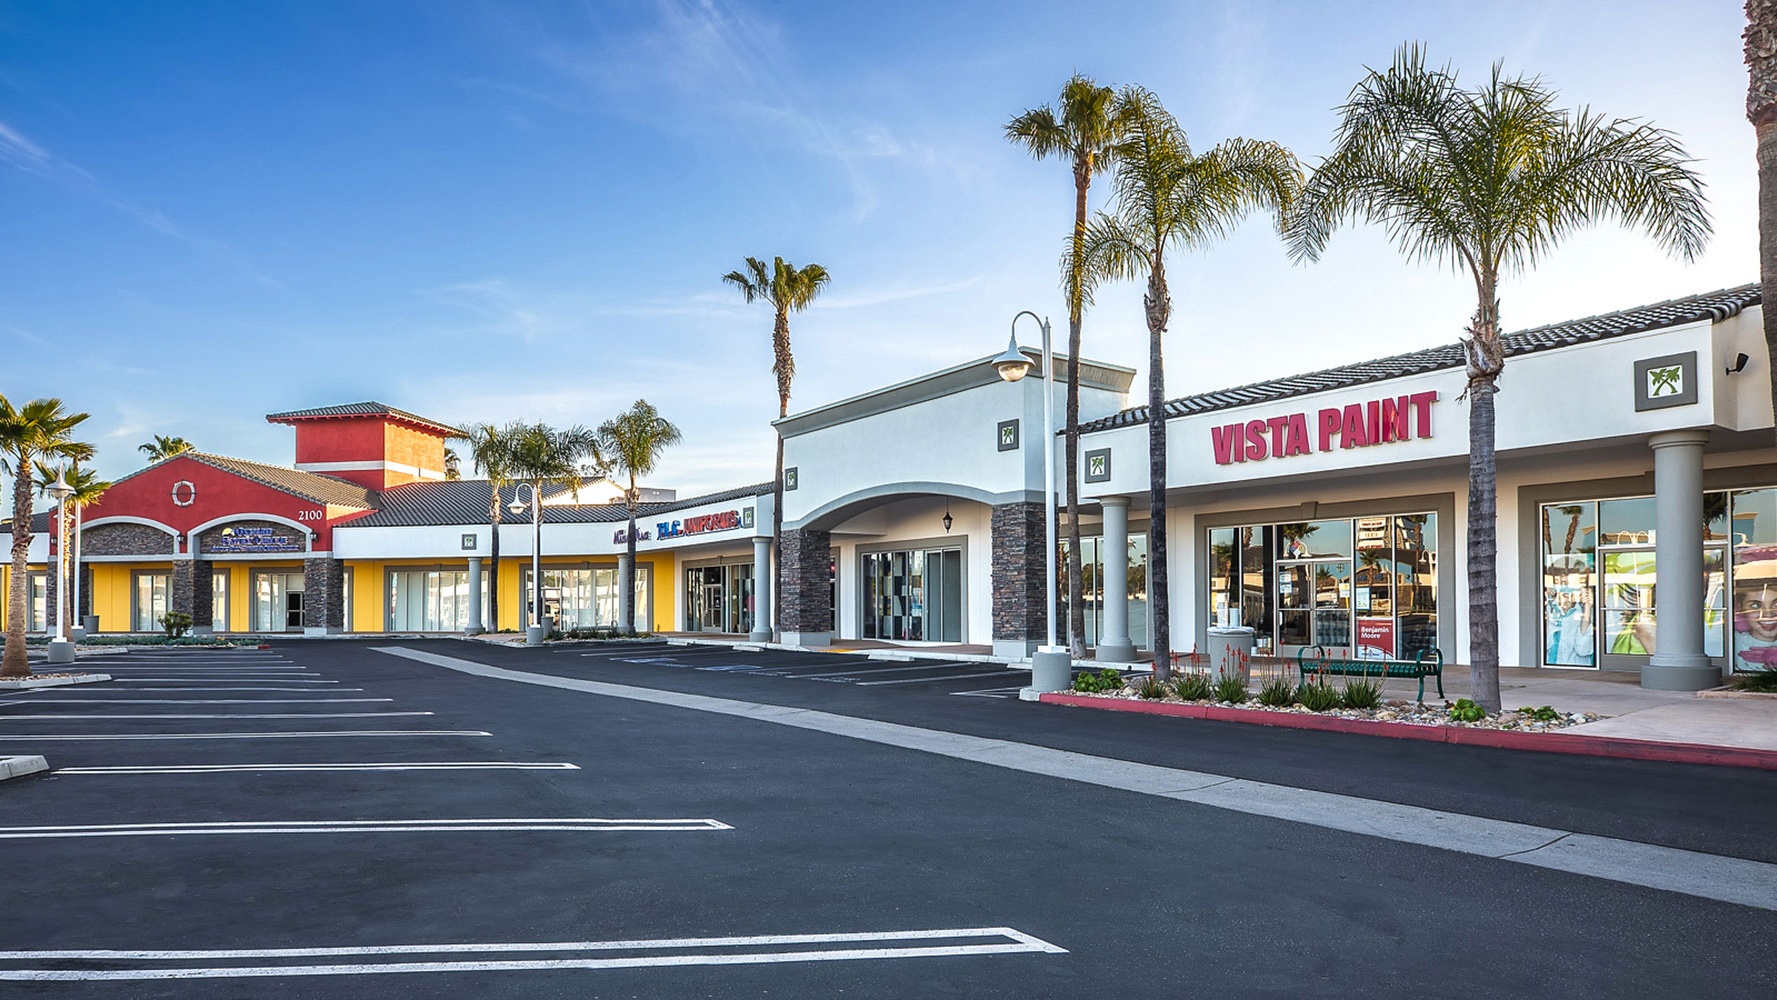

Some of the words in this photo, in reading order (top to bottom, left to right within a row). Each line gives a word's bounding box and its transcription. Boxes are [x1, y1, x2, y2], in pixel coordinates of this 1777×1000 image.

[1211, 412, 1312, 465] VISTA
[1318, 390, 1439, 452] PAINT
[298, 510, 322, 520] 2100
[683, 510, 739, 534] UNIFORMS
